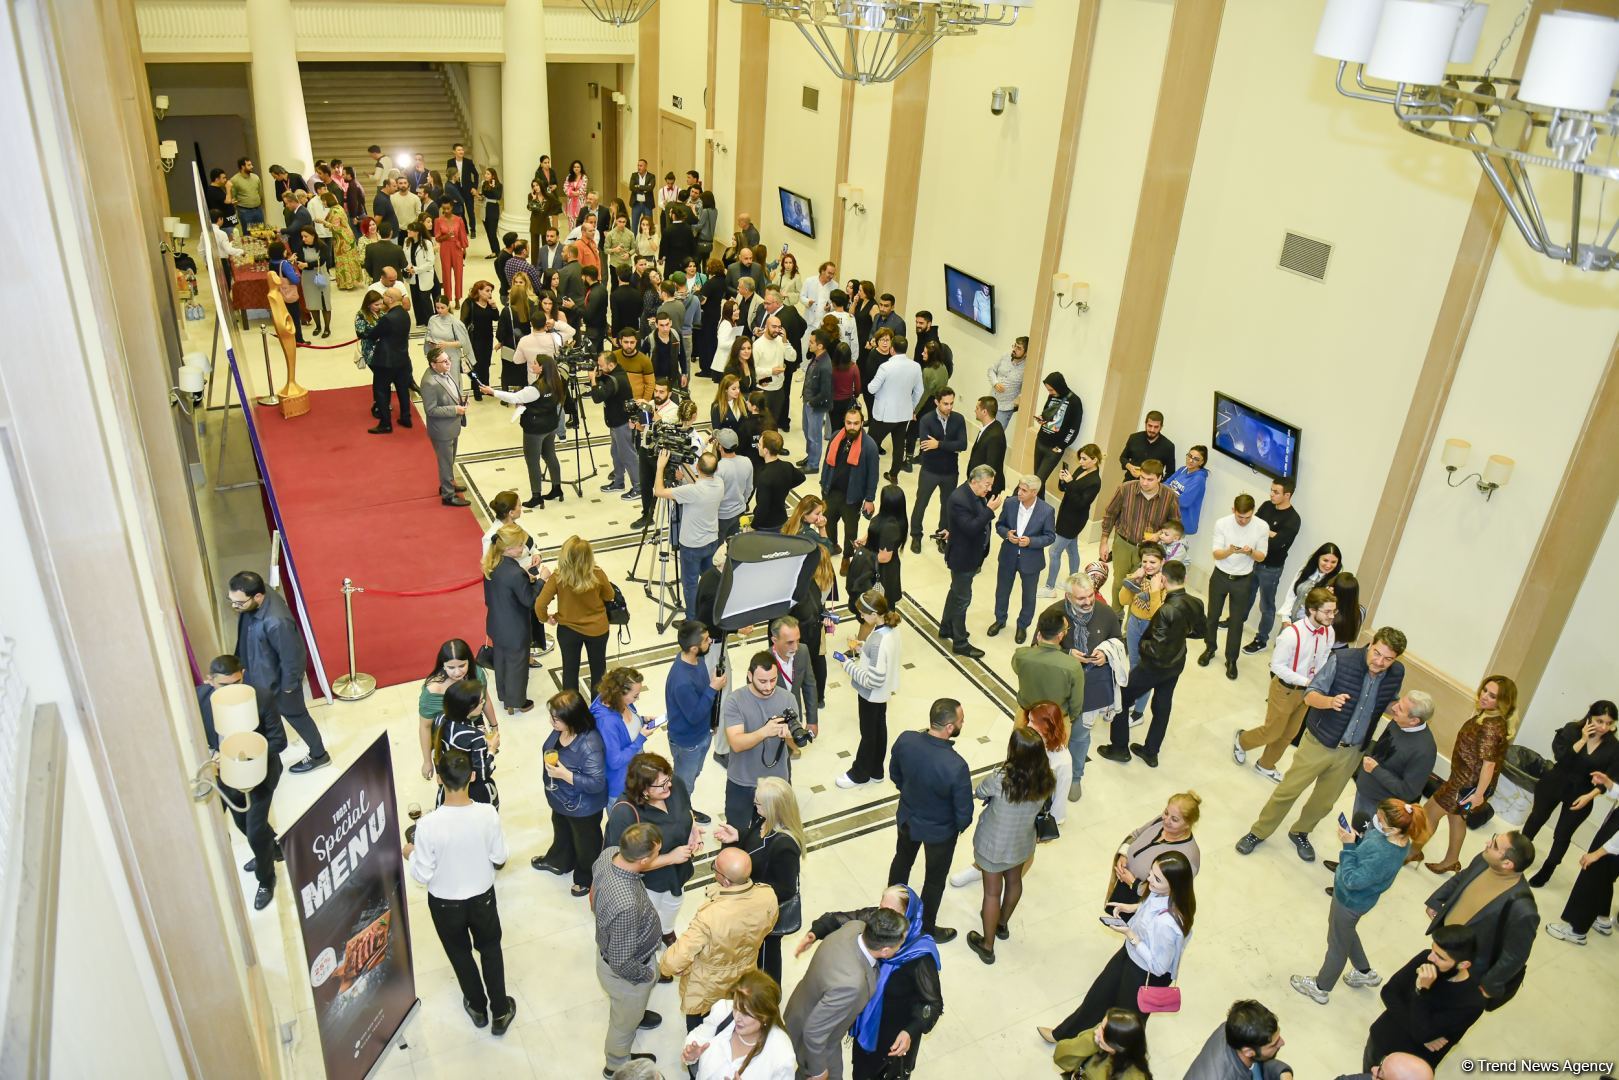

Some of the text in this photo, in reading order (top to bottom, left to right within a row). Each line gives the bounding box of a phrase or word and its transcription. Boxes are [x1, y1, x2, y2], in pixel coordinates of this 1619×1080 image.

[312, 789, 370, 862] Special
[332, 798, 351, 825] TODAY
[301, 801, 386, 919] MENU
